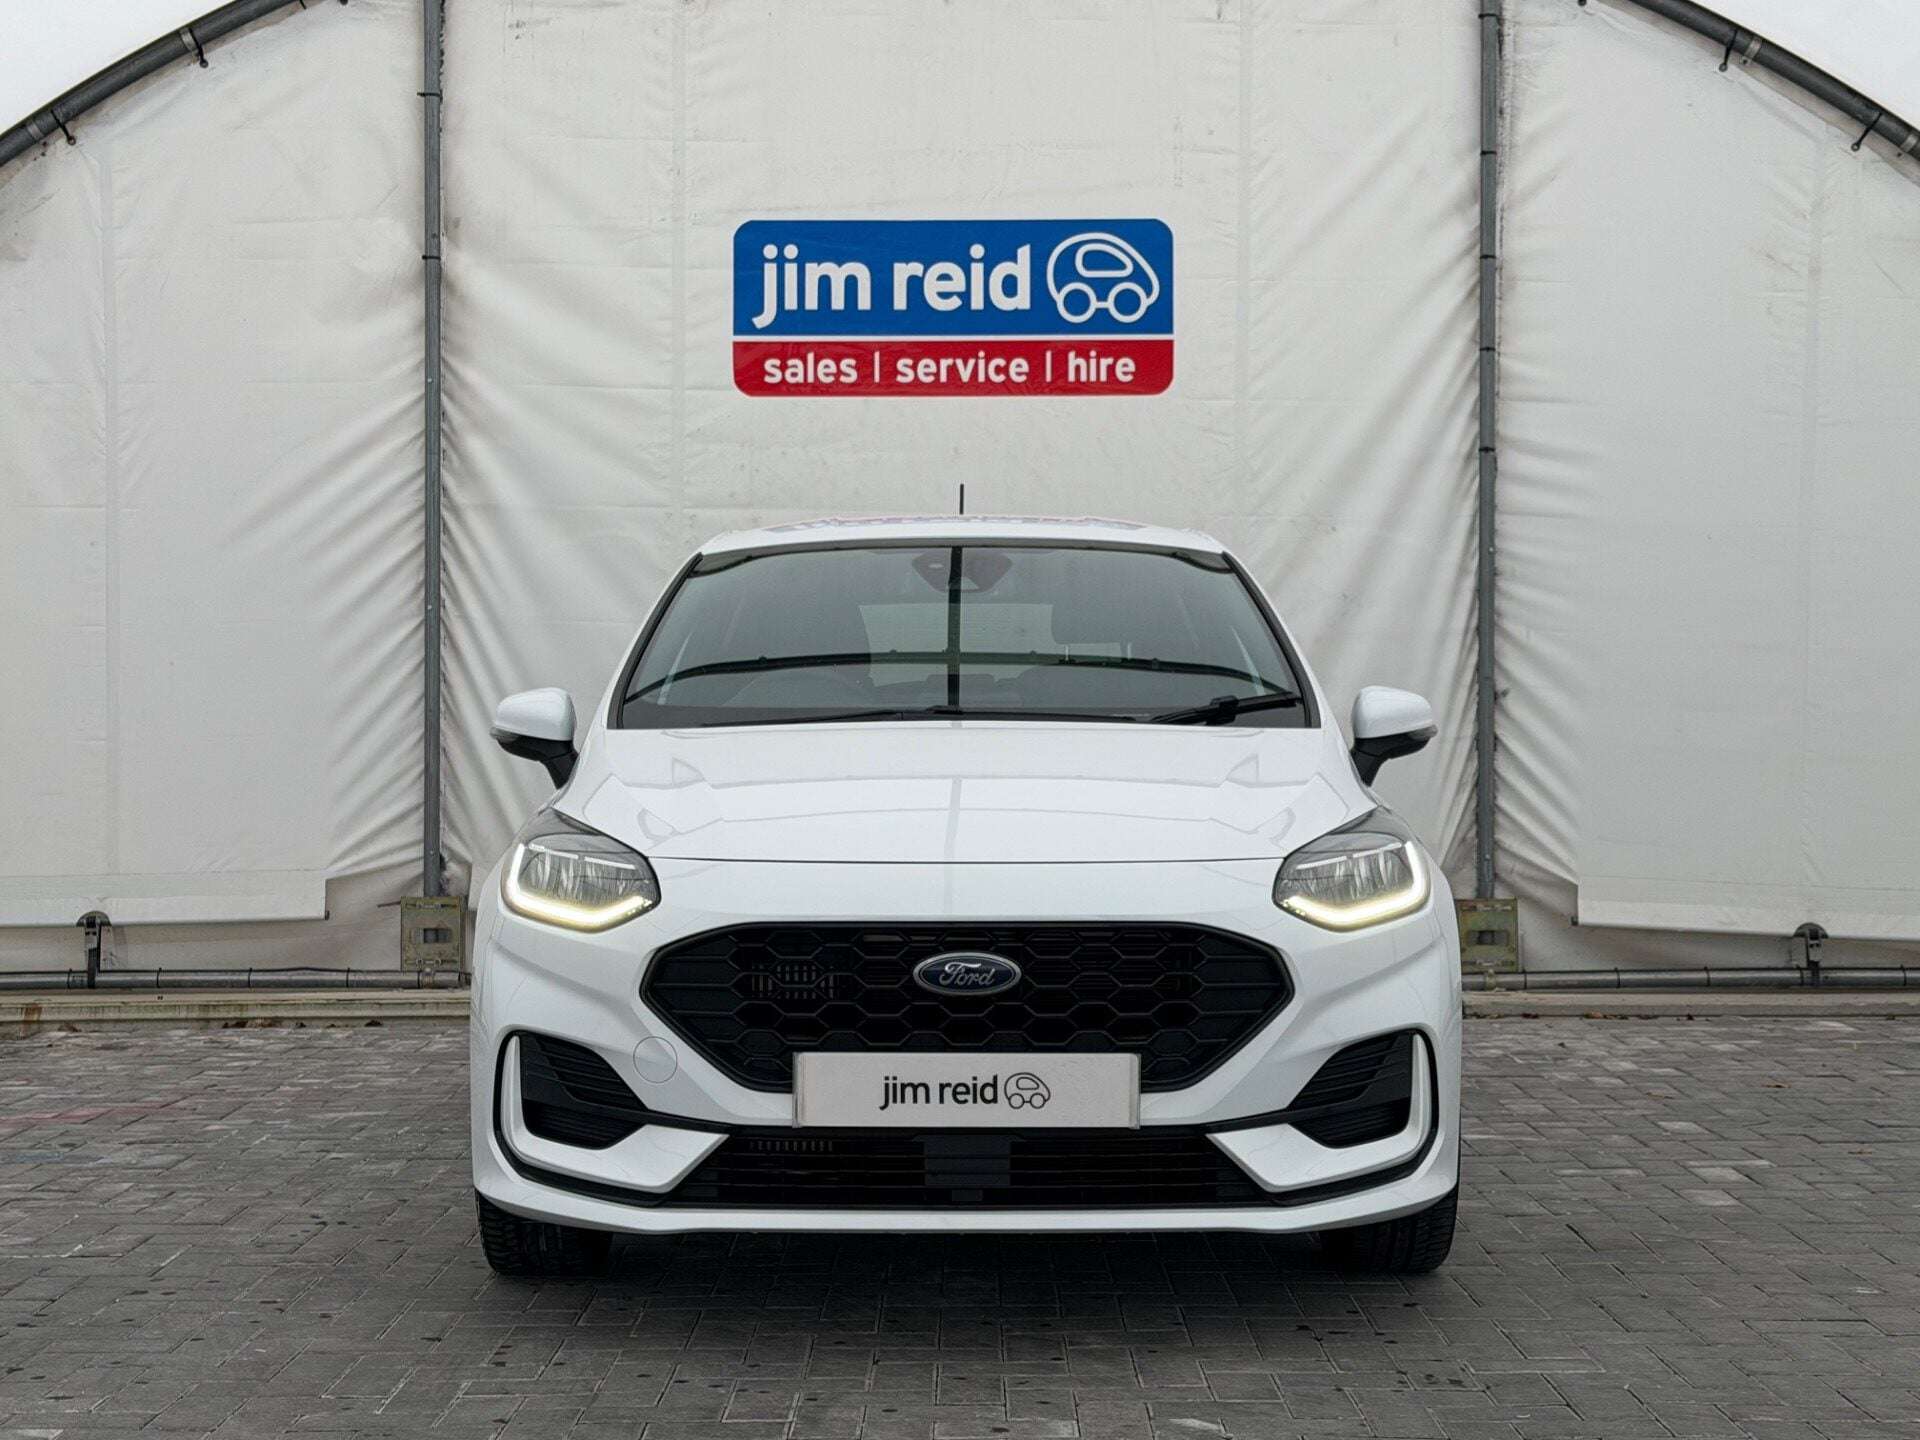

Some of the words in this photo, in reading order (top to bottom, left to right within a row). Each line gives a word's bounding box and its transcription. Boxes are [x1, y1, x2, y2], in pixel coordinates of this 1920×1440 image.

[751, 244, 871, 329] jim
[893, 244, 1031, 311] reid
[763, 352, 858, 384] sales
[896, 351, 1029, 384] service
[1067, 350, 1136, 383] hire
[939, 961, 996, 986] Ford
[879, 1076, 930, 1111] jim
[938, 1074, 999, 1105] reid
